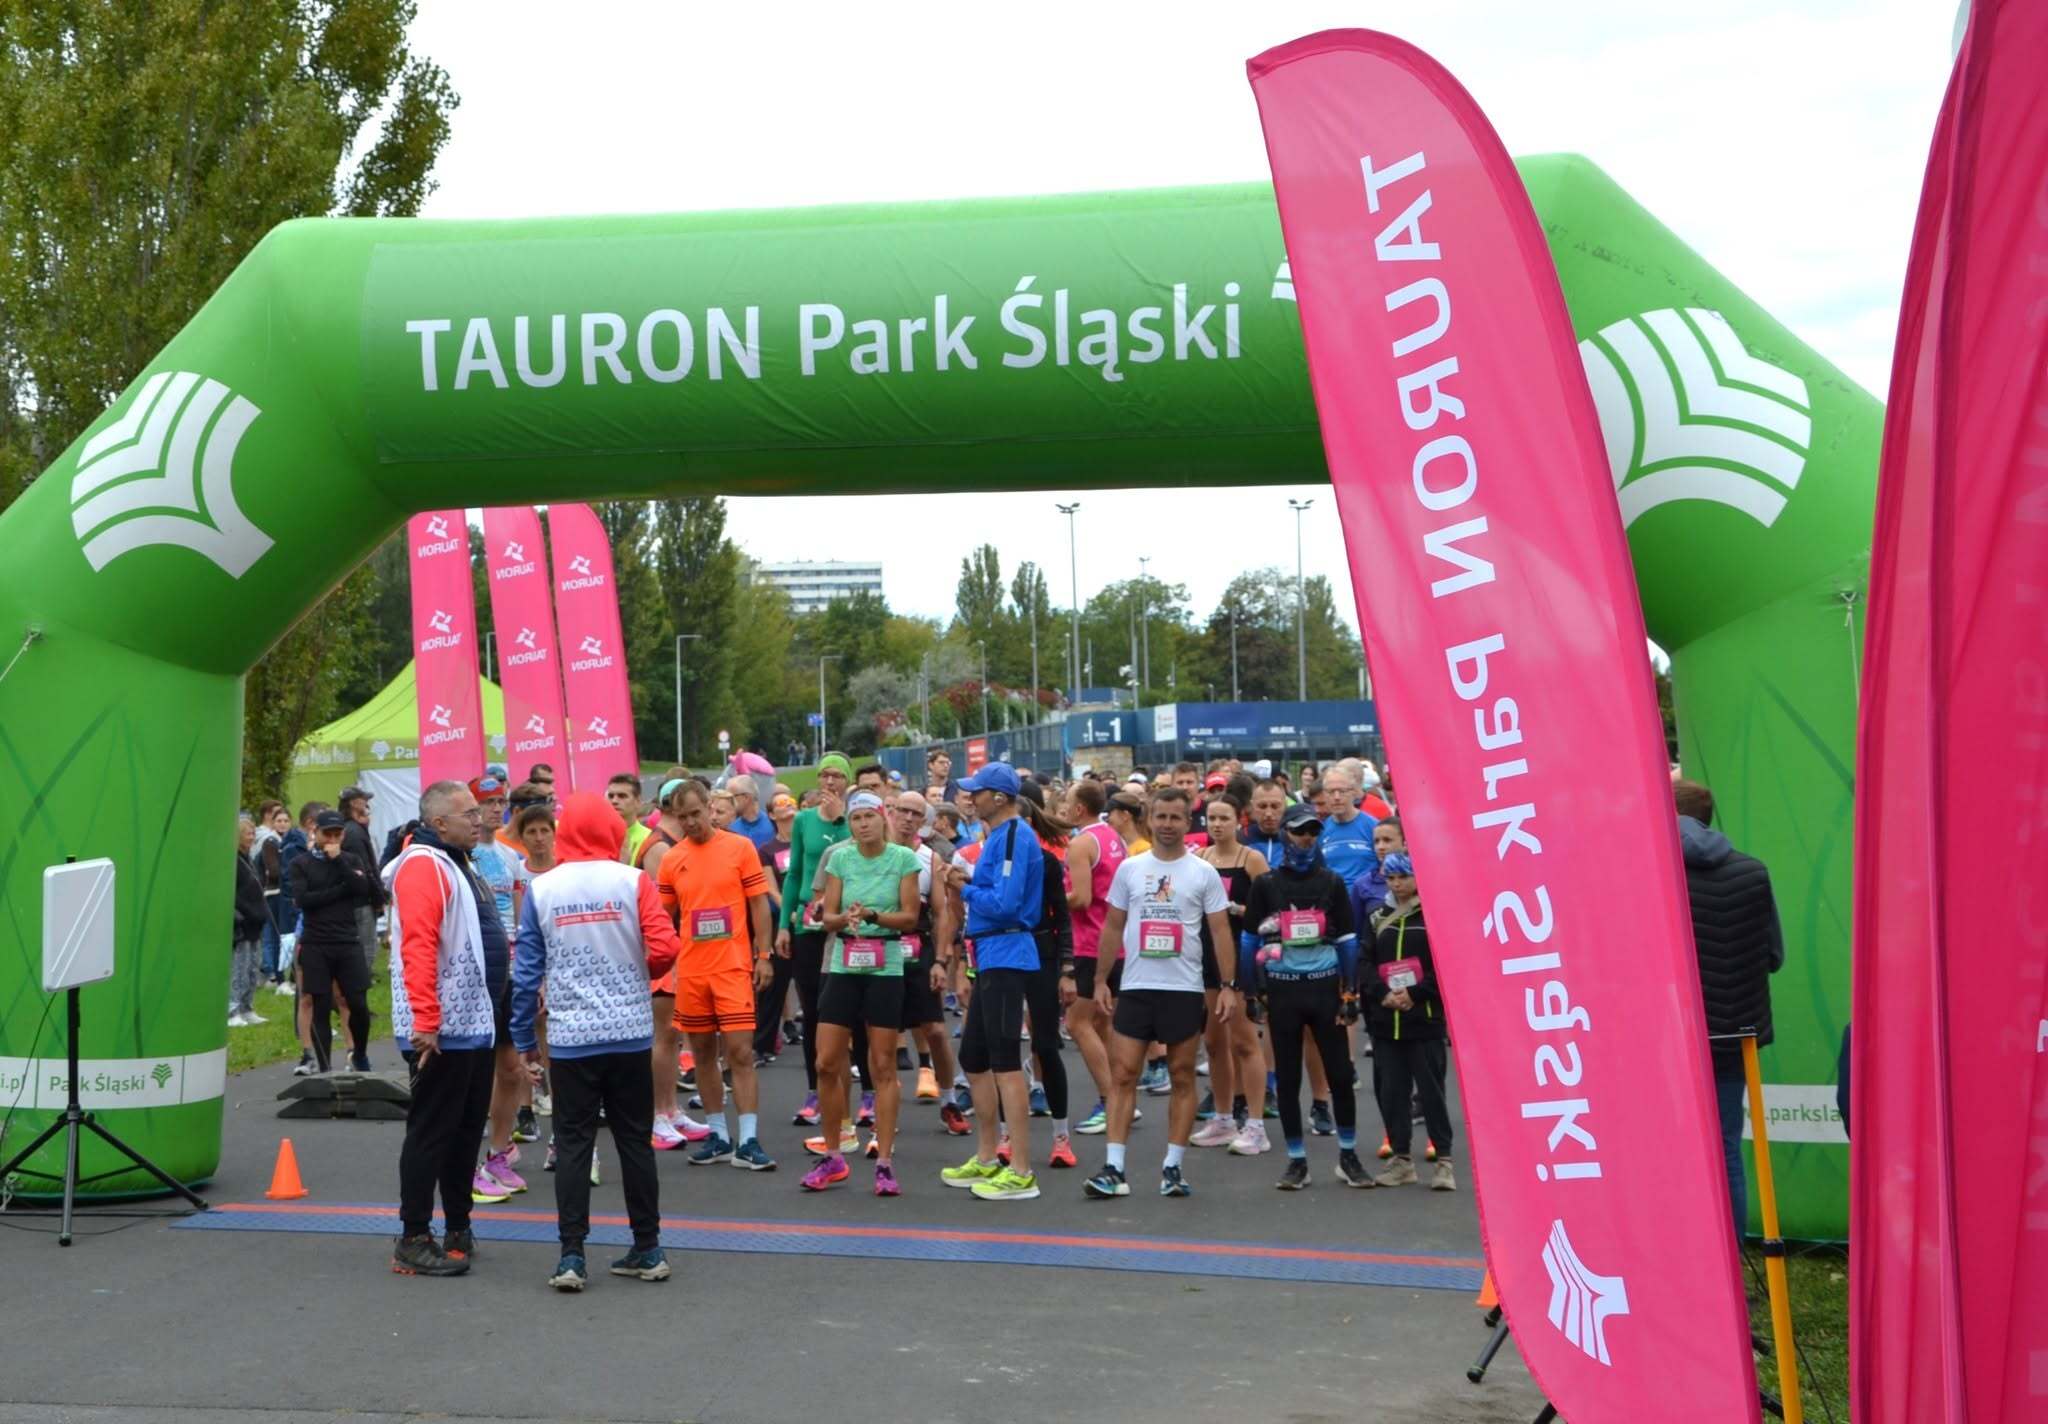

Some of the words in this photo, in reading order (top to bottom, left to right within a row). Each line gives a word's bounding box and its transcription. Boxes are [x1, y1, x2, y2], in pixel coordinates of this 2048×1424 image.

[406, 306, 762, 390] TAURON
[800, 294, 977, 375] Park
[1001, 276, 1241, 382] Śląski
[552, 900, 622, 916] TIMING4U
[701, 922, 720, 932] 210
[1149, 937, 1168, 948] 217
[50, 1074, 89, 1091] Pak
[95, 1072, 145, 1094] Śląski
